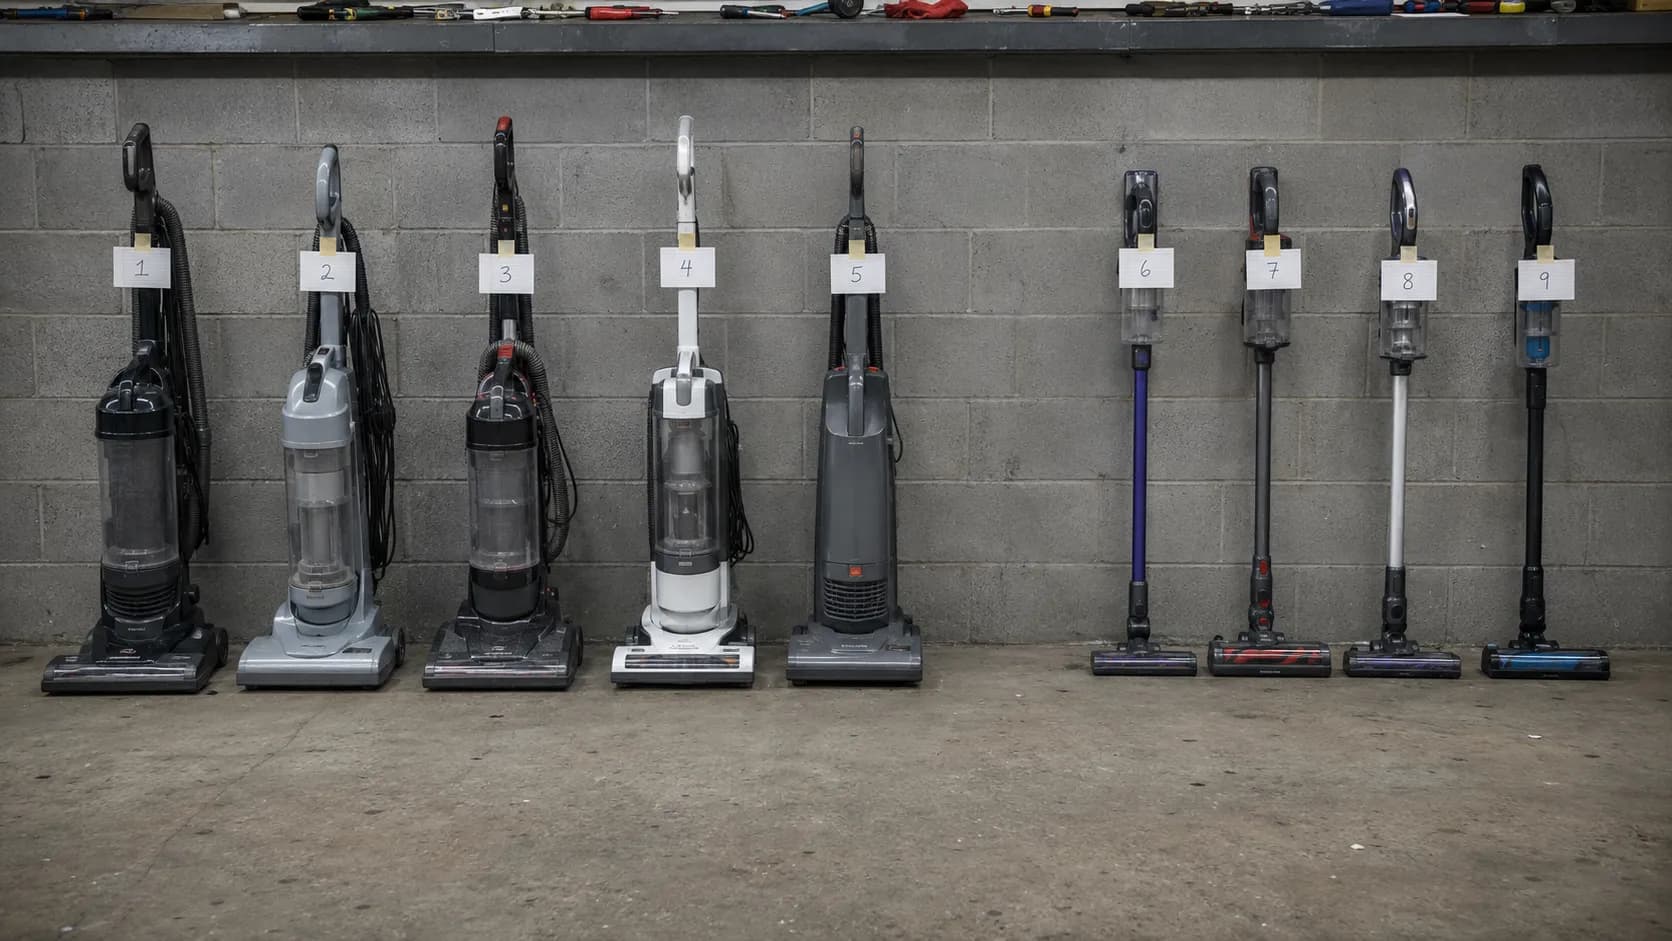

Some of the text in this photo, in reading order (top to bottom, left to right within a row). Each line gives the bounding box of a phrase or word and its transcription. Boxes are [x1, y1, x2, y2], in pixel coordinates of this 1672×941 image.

[135, 260, 149, 276] 1
[320, 264, 334, 280] 2
[500, 265, 511, 282] 3
[680, 260, 692, 278] 4
[851, 265, 863, 282] 5
[1140, 259, 1150, 277] 6
[1266, 261, 1279, 279] 7
[1402, 272, 1413, 289] 8
[1539, 271, 1549, 289] 9
